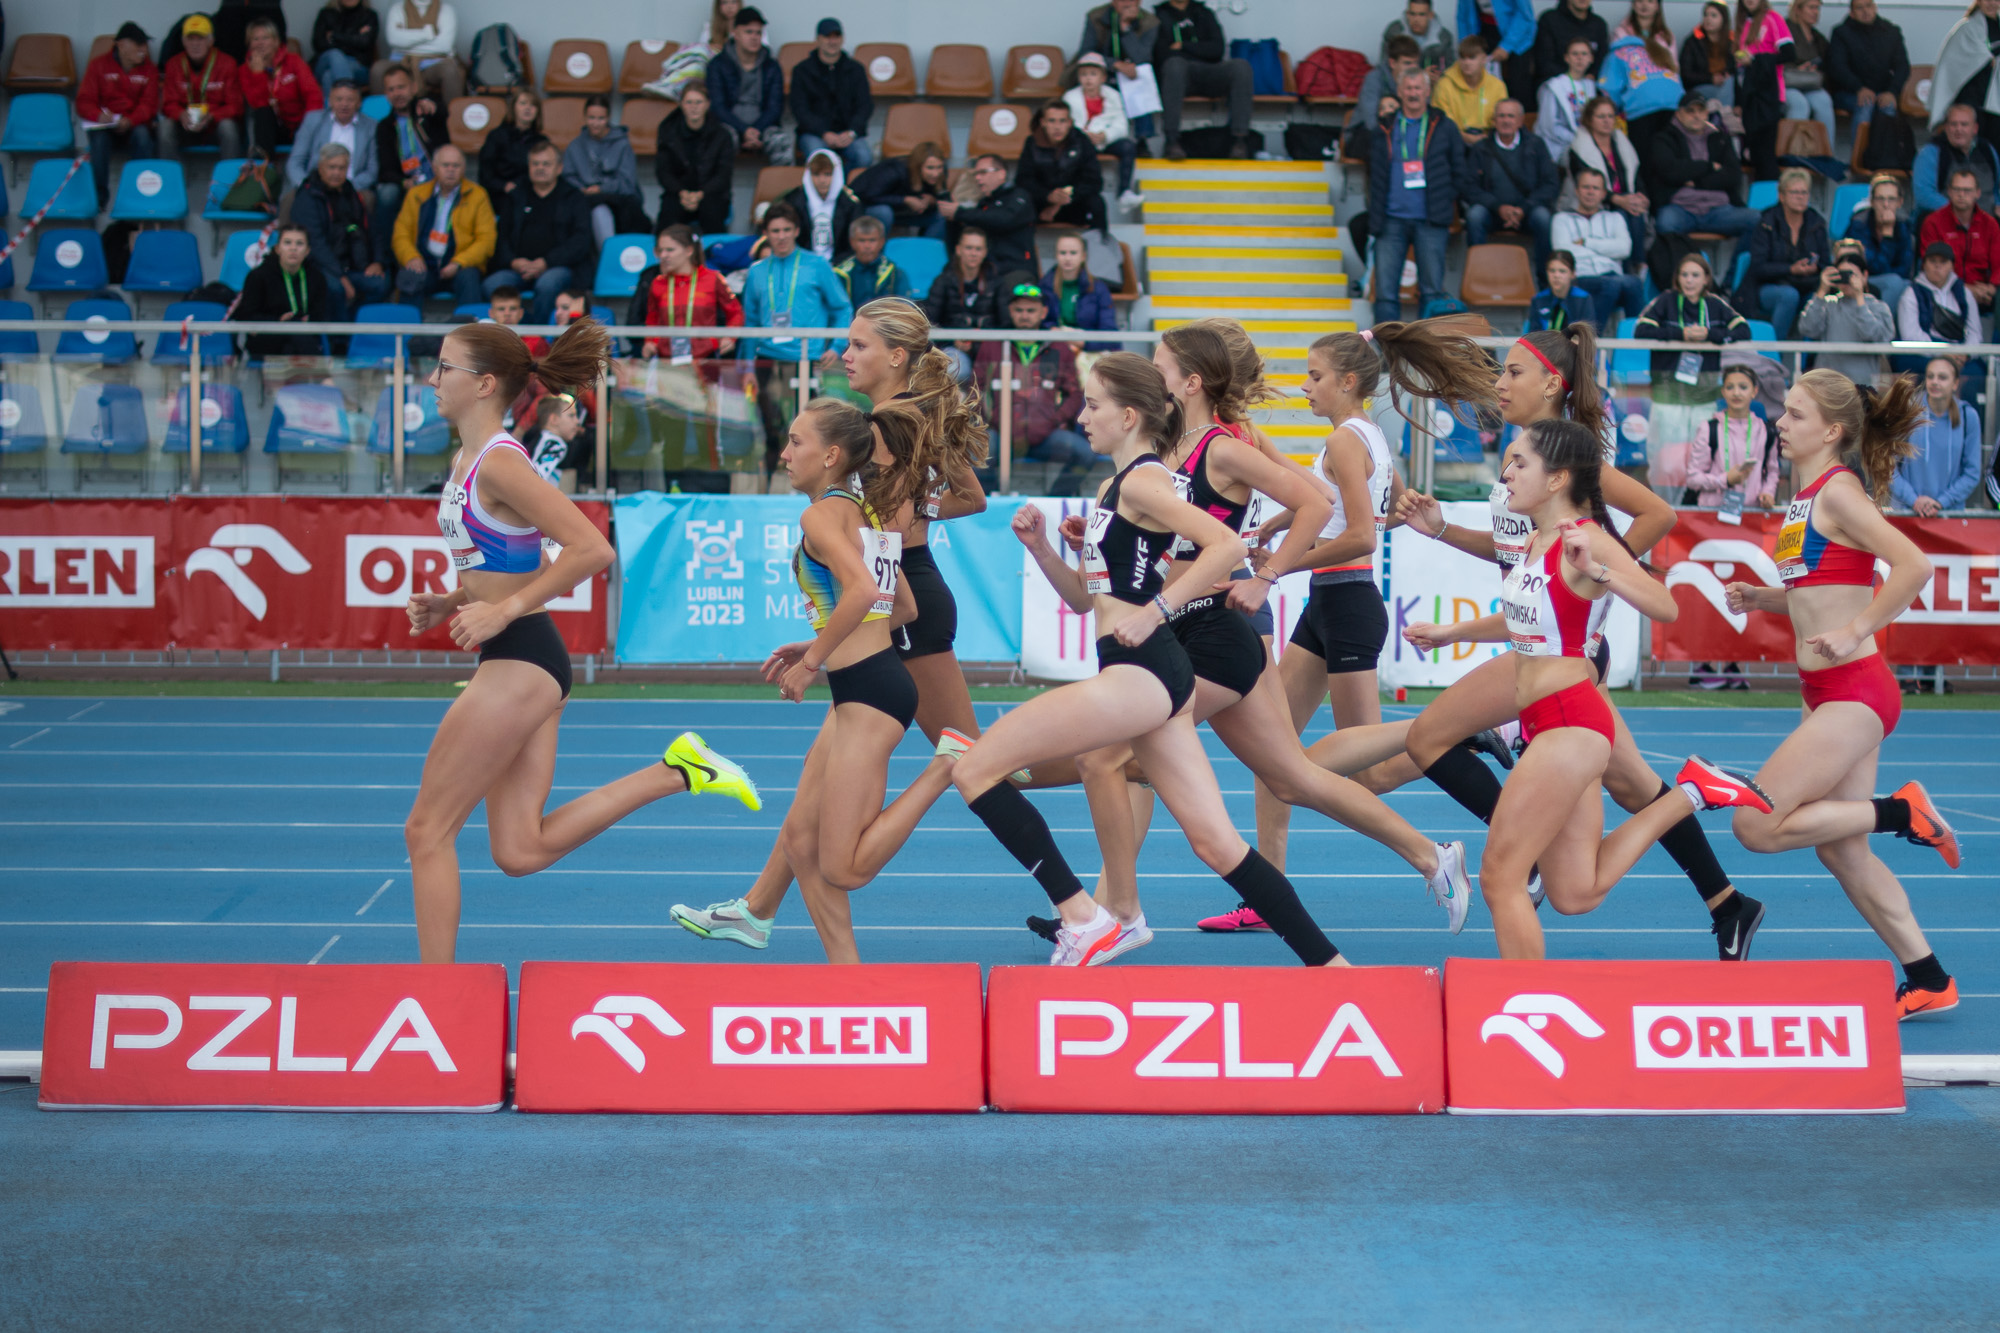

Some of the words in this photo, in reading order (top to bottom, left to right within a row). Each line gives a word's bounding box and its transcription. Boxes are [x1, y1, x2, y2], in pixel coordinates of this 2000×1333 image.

[1789, 502, 1809, 521] 841
[875, 556, 901, 591] 979
[686, 586, 744, 602] LUBLIN
[1187, 597, 1214, 613] PRO
[687, 603, 746, 626] 2023
[1517, 642, 1534, 653] 2022
[90, 994, 458, 1072] PZLA
[725, 1015, 912, 1056] ORLEN
[1039, 1000, 1403, 1078] PZLA
[1648, 1015, 1851, 1059] ORLEN
